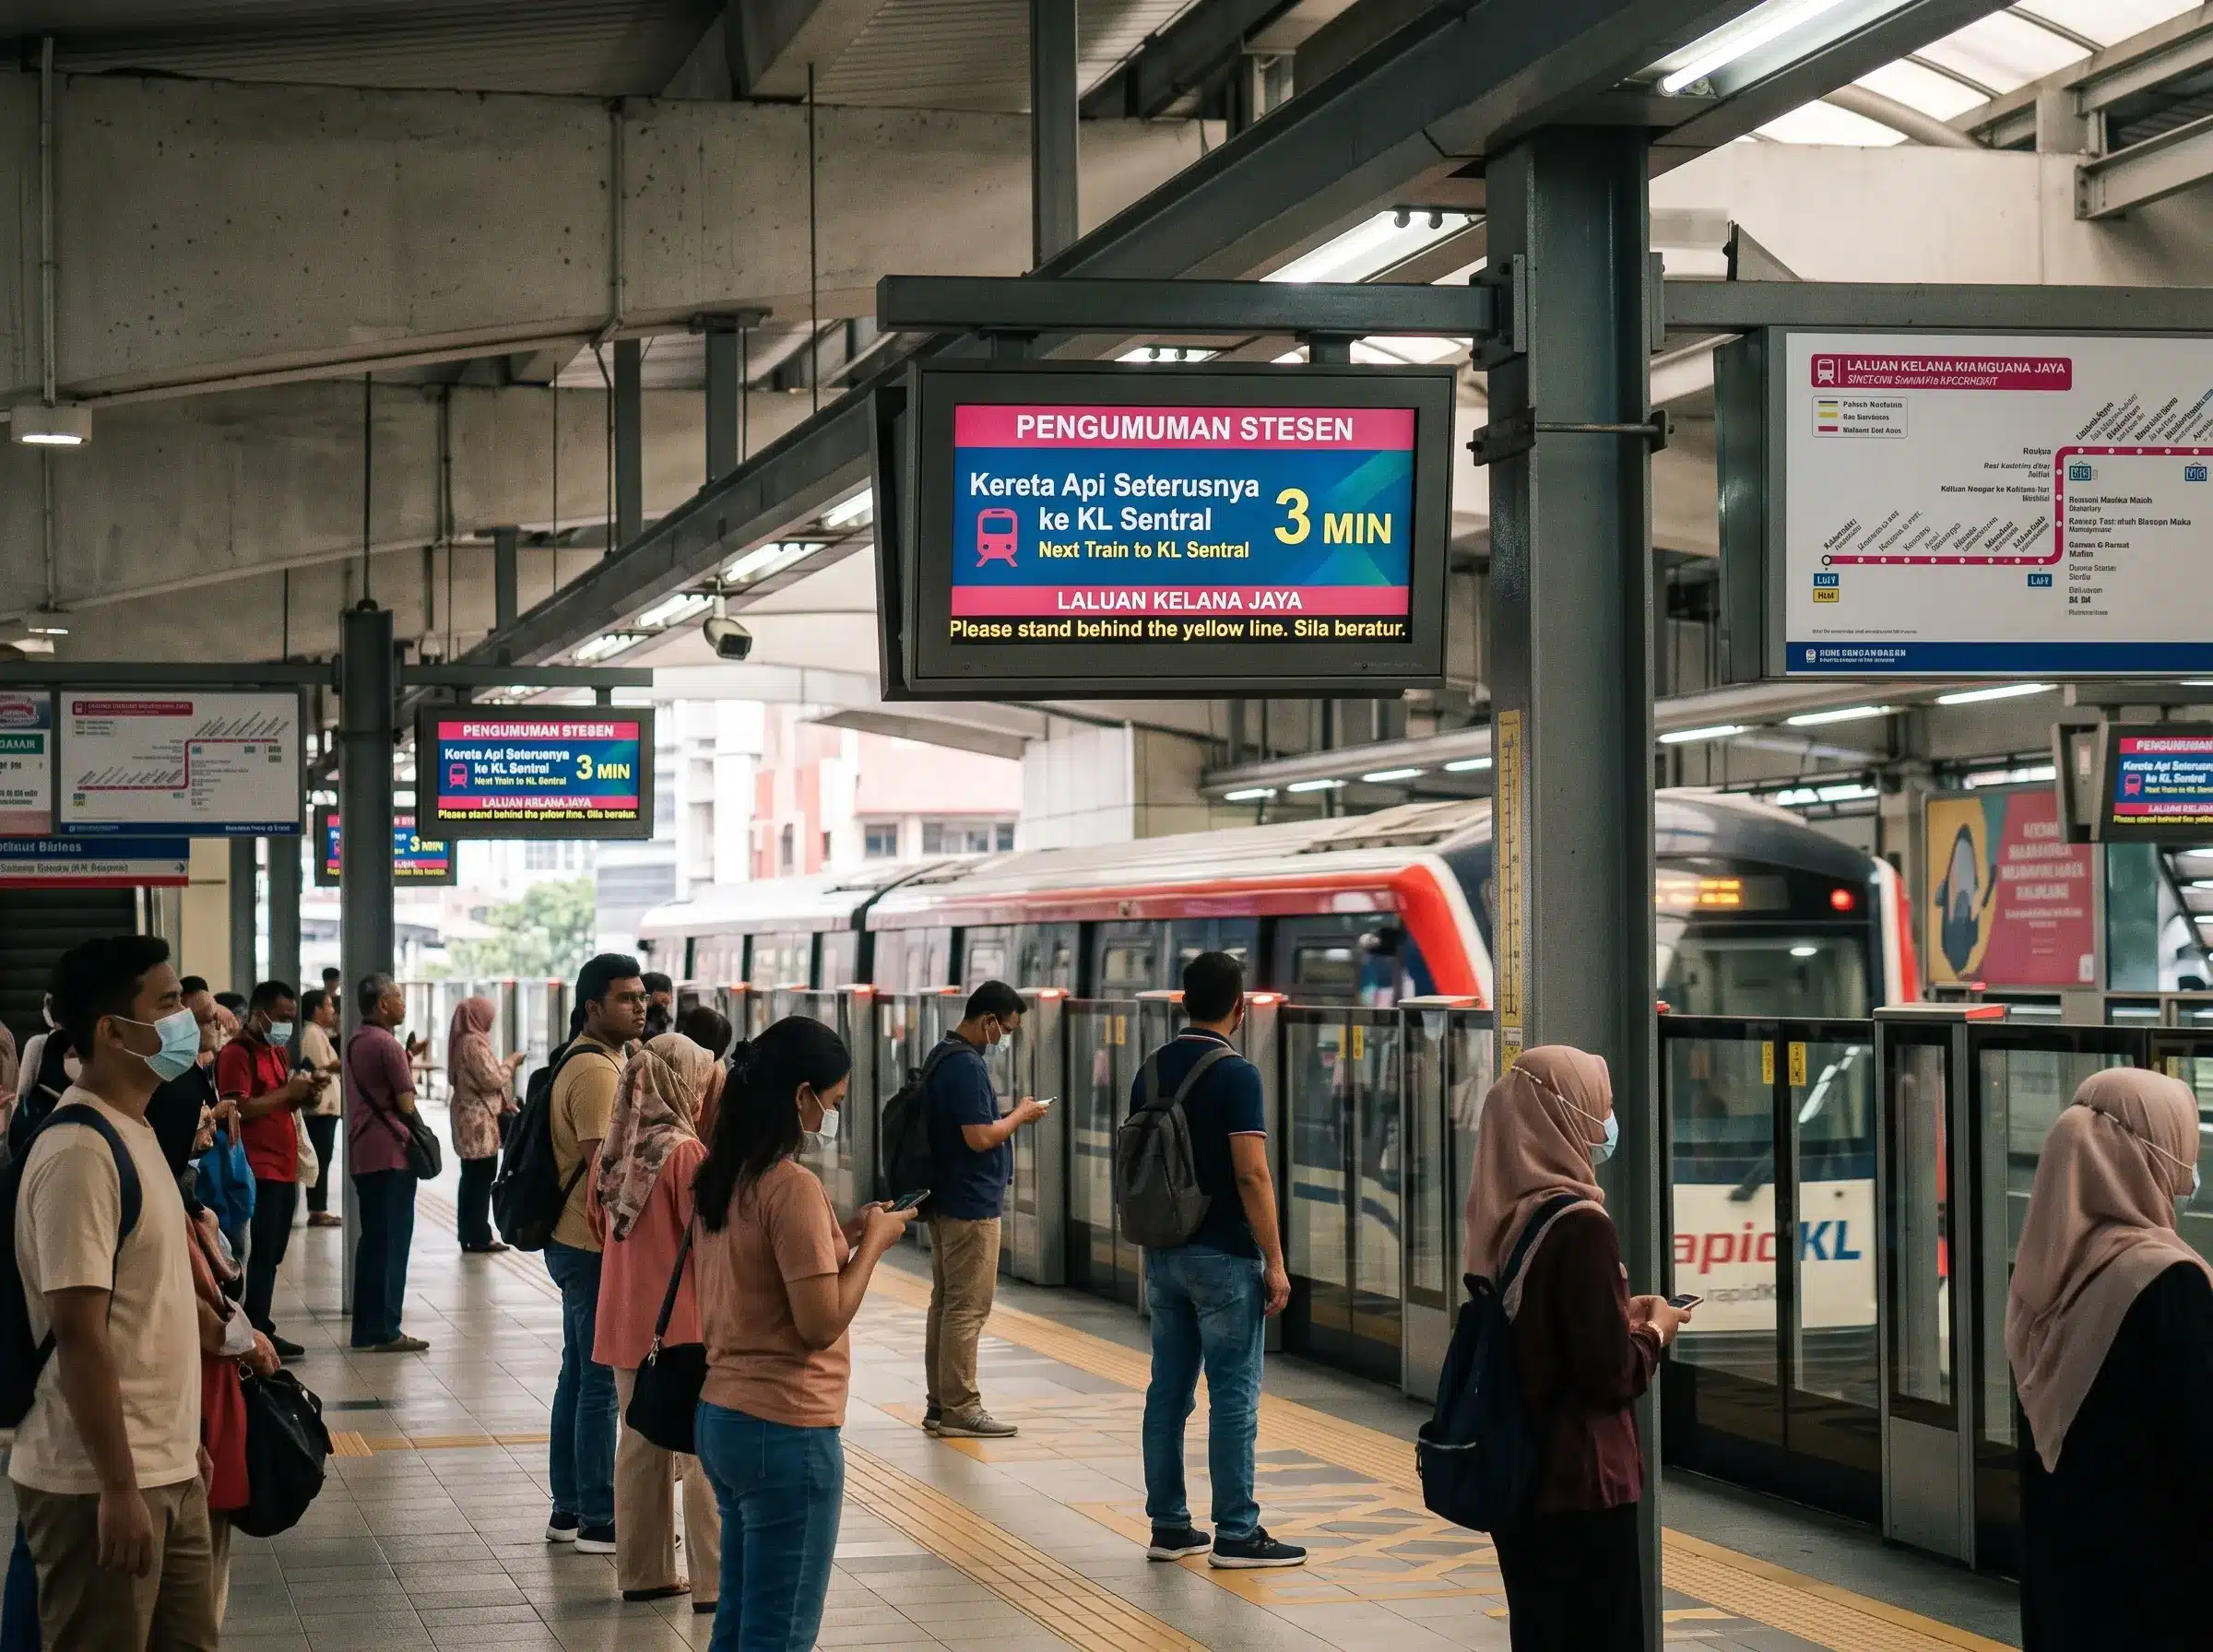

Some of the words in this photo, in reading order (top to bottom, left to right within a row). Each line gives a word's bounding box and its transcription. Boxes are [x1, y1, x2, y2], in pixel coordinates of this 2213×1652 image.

[1847, 360, 1898, 371] LALUAN
[1901, 360, 1952, 372] KELANA
[2034, 362, 2065, 373] JAYA
[1016, 415, 1231, 440] PENGUMUMAN
[1240, 417, 1354, 441] STESEN
[970, 472, 1055, 497] Kereta
[1061, 472, 1105, 502] Api
[1114, 472, 1260, 504] Seterusnya
[1039, 507, 1070, 531] ke
[1078, 507, 1113, 531] KL
[1120, 507, 1212, 531] Sentral
[1274, 488, 1311, 545] 3
[1323, 513, 1392, 545] MIN
[1039, 541, 1080, 558] Next
[1084, 541, 1129, 558] Train
[1134, 542, 1153, 558] to
[1157, 541, 1181, 558] KL
[1187, 541, 1249, 558] Sentral
[1058, 591, 1146, 609] LALUAN
[1154, 591, 1244, 609] KELANA
[1249, 591, 1304, 609] JAYA
[950, 620, 1012, 638] Please
[1018, 620, 1071, 638] stand
[1077, 620, 1142, 638] behind
[1148, 620, 1178, 638] the
[1183, 620, 1245, 642] yellow
[1249, 620, 1288, 637] line.
[1294, 620, 1329, 637] Sila
[1334, 620, 1406, 637] beratur.
[491, 762, 506, 773] KL
[576, 754, 594, 780] 3
[598, 763, 631, 780] MIN
